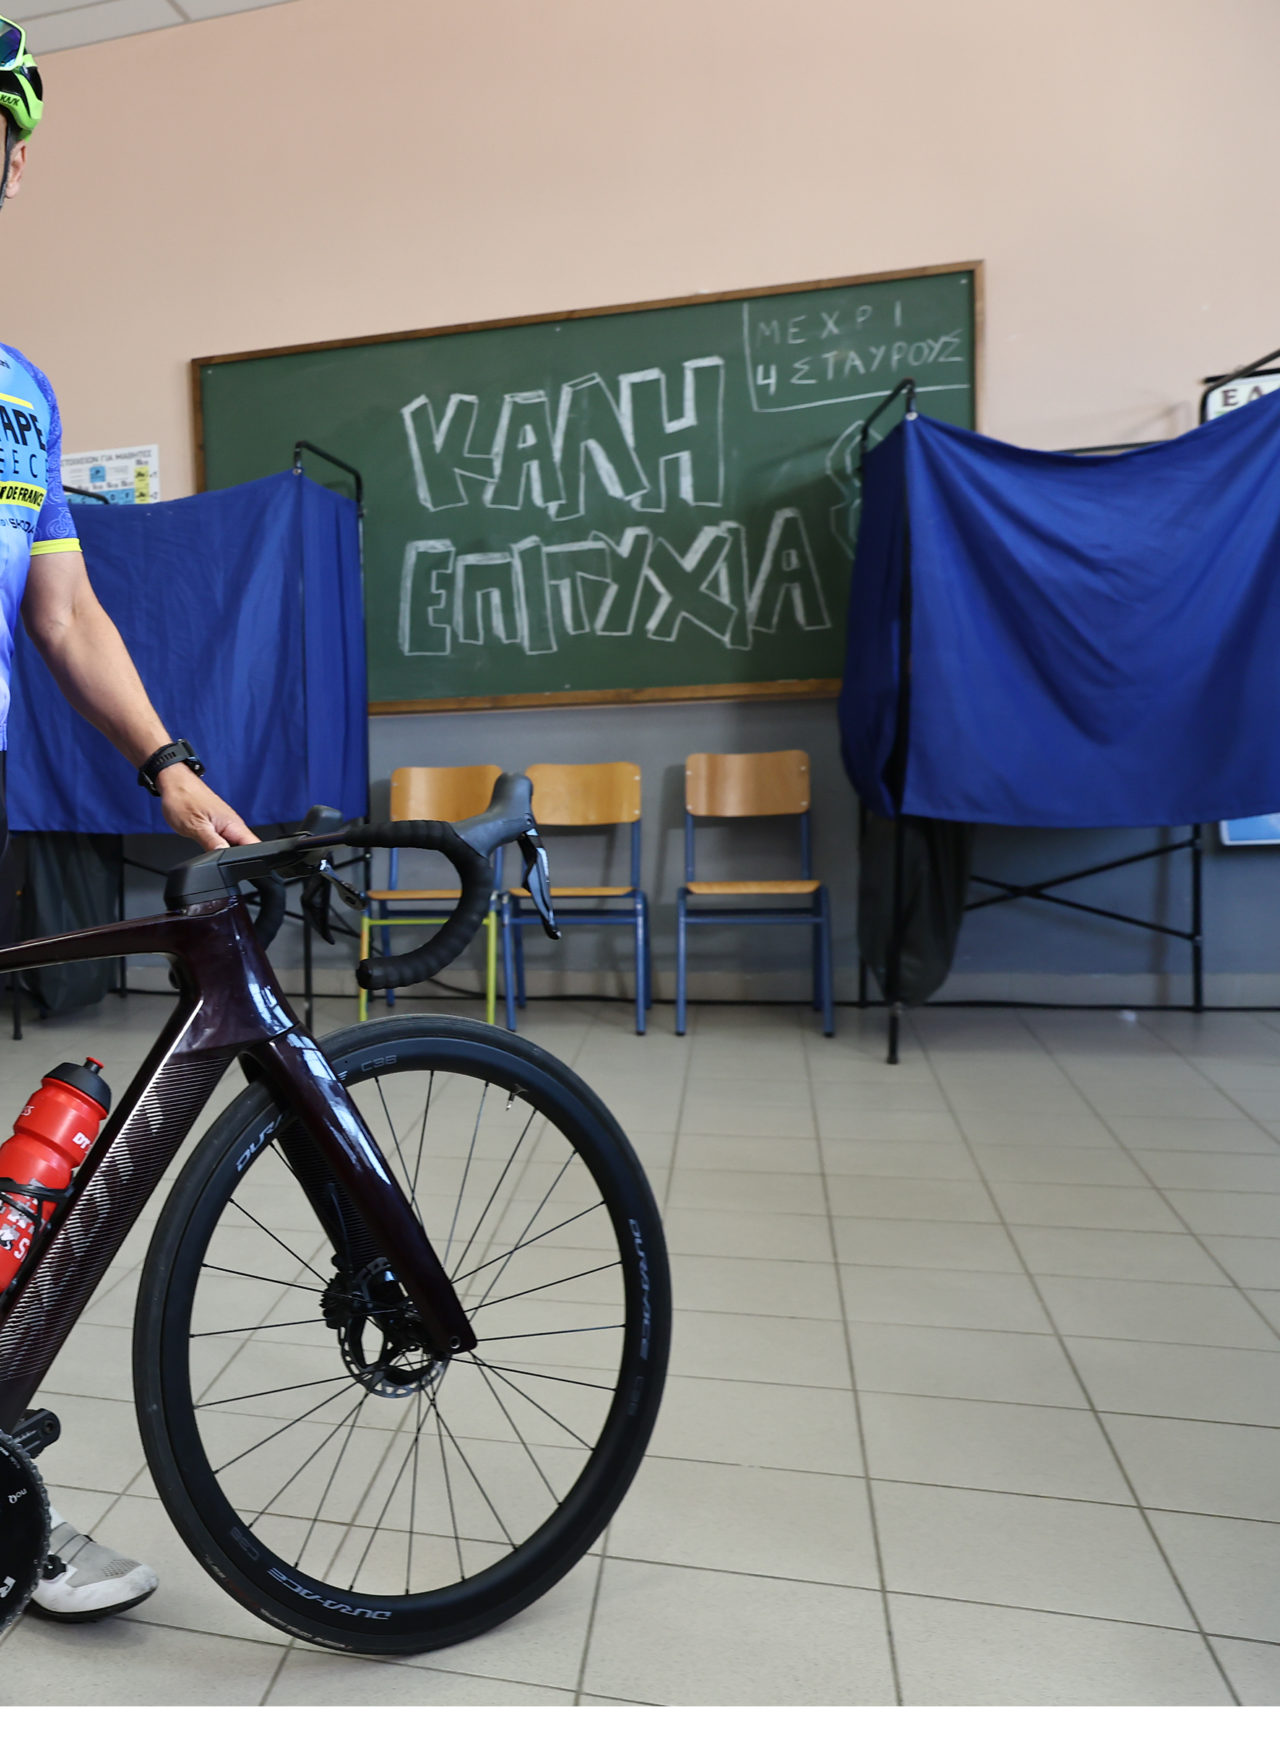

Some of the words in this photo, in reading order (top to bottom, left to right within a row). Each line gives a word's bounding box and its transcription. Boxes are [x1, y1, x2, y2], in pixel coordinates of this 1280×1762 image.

[757, 300, 902, 347] ΜΕΧΡΙ
[756, 363, 777, 395] 4
[789, 328, 965, 385] ΣΤΑΥΡΟΥΣ
[401, 356, 725, 523] ΚΑΛΗ
[6, 486, 19, 500] DE
[399, 507, 832, 655] ΕΠΙΤΥΧΙΑ
[267, 1567, 393, 1621] DURA-ACE
